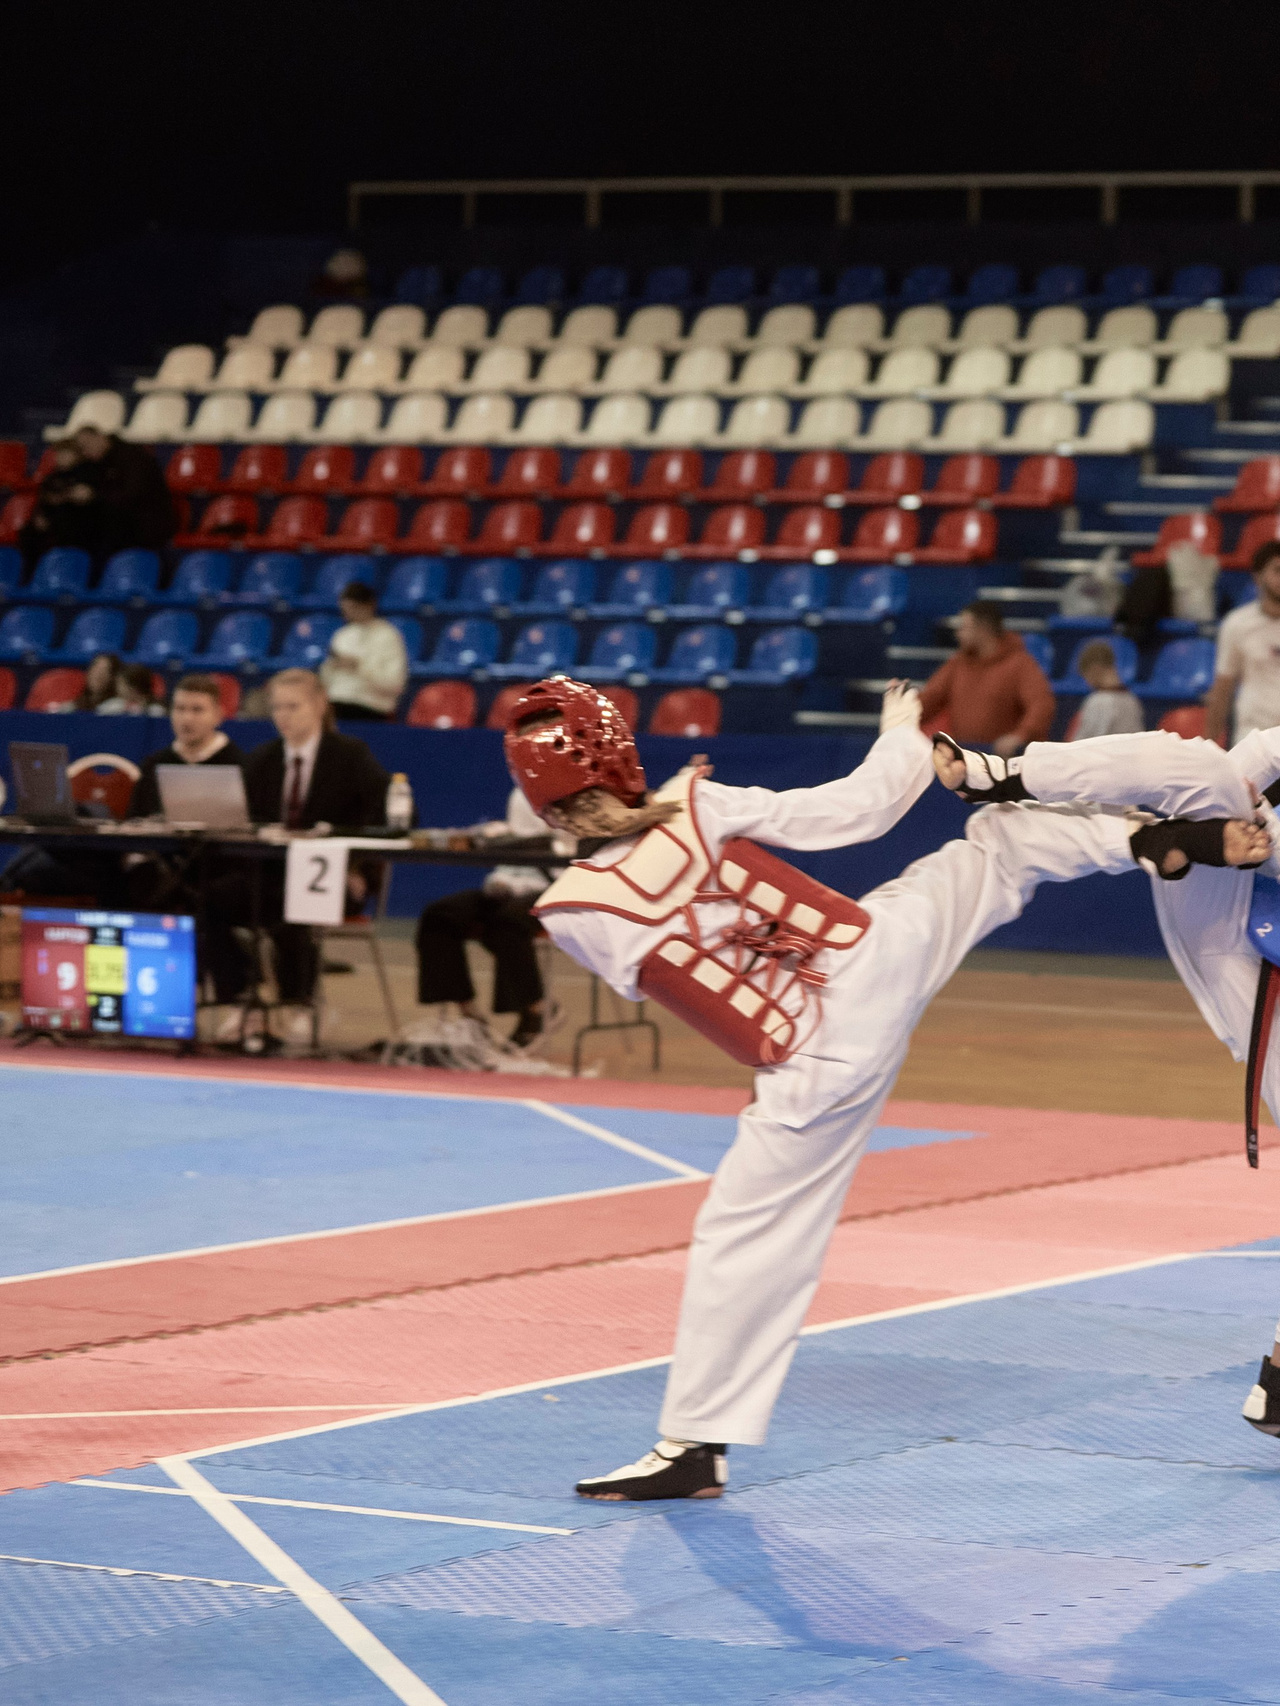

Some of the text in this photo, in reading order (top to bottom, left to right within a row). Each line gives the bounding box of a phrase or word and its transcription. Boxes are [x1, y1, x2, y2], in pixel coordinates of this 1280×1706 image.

[307, 855, 328, 893] 2
[1255, 922, 1273, 938] 2
[56, 962, 77, 991] 9
[136, 967, 159, 996] 6
